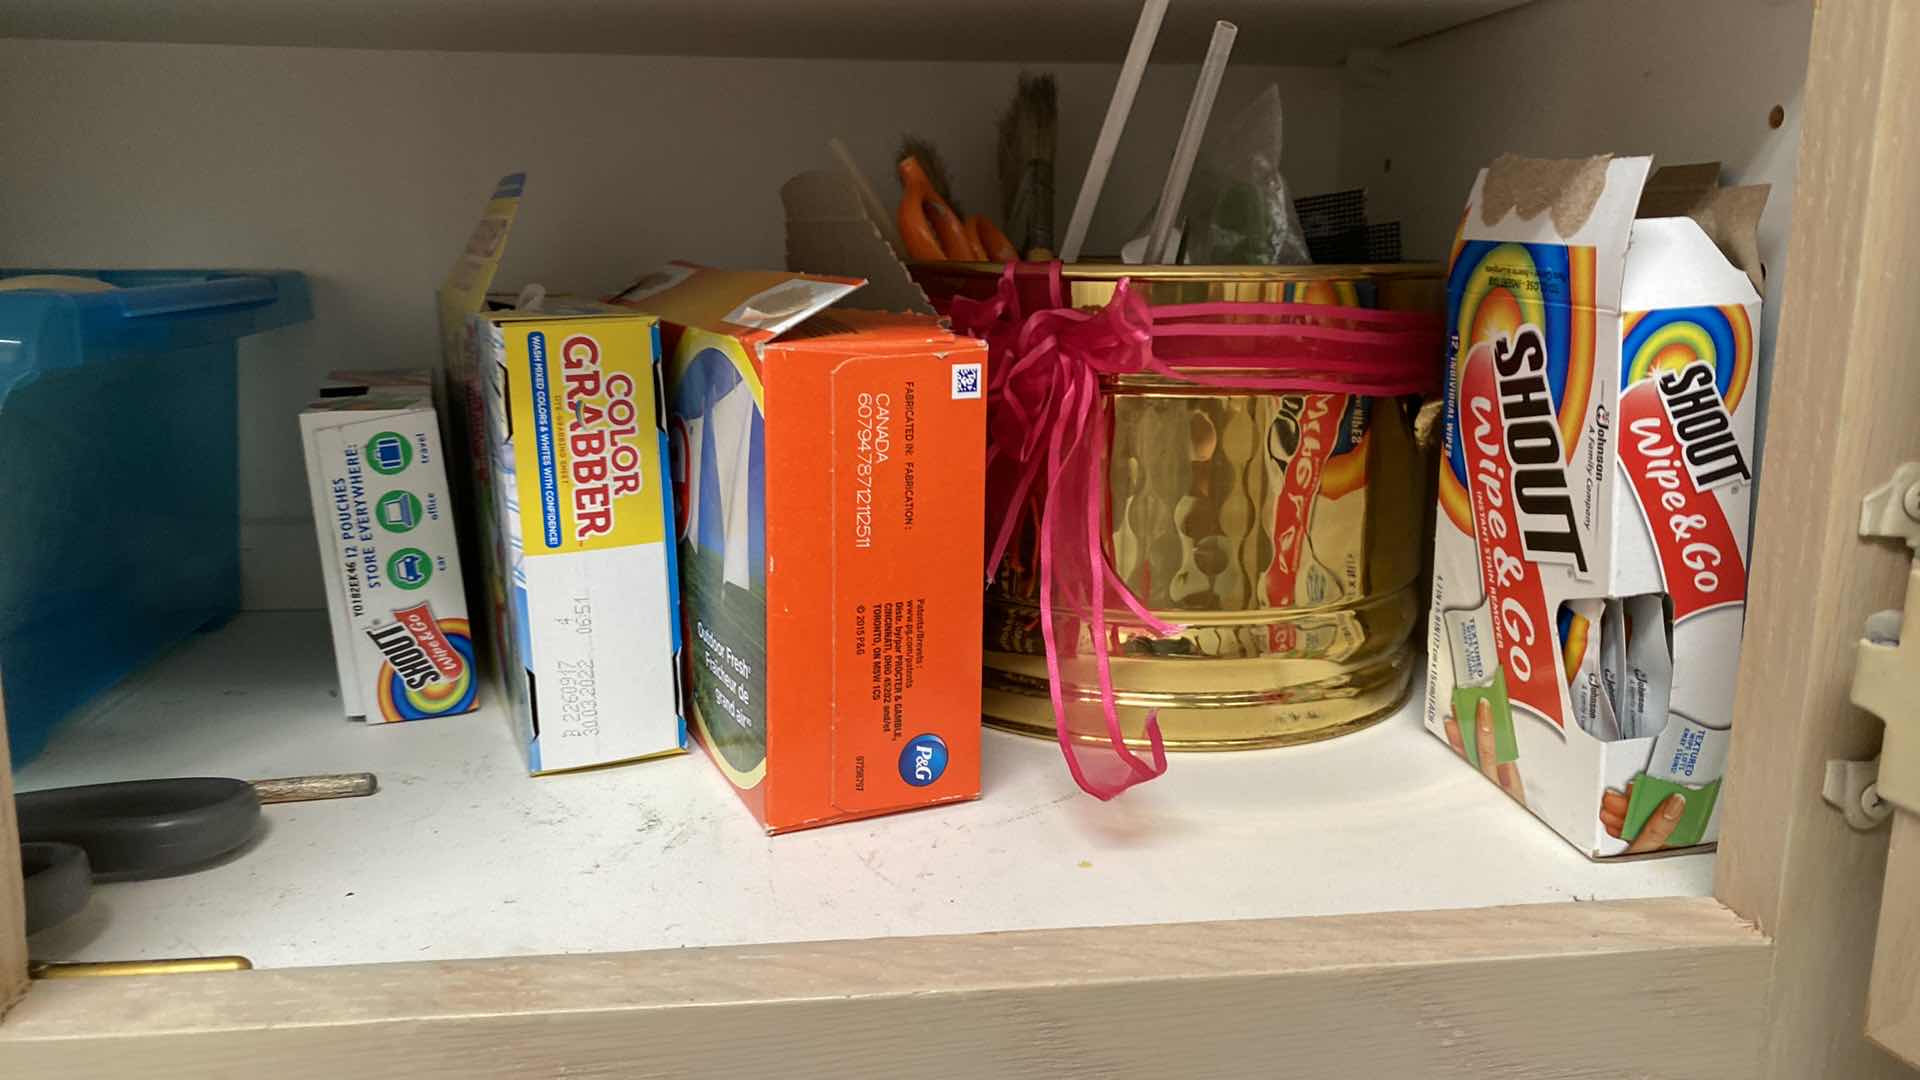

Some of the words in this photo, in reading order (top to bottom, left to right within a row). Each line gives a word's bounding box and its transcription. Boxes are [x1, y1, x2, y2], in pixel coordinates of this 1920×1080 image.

[531, 335, 542, 361] WASH
[535, 362, 545, 390] MIXED
[537, 390, 548, 425] COLORS
[875, 393, 890, 464] CANADA
[905, 381, 914, 442] FABRICATED
[1659, 364, 1751, 487] SHOUT
[416, 433, 429, 464] travel
[541, 433, 551, 465] WHITES
[562, 336, 612, 538] GRABBER
[606, 374, 640, 495] COLOR
[1494, 330, 1588, 573] SHOUT
[1586, 437, 1595, 476] Family
[1596, 404, 1609, 481] Johnson
[544, 466, 553, 489] WITH
[1471, 396, 1507, 539] Wipe
[333, 478, 351, 541] POUCHES
[347, 444, 373, 543] EVERYWHERE:
[427, 492, 439, 521] office
[1477, 491, 1491, 541] INSTANT
[1584, 478, 1593, 530] Company
[545, 490, 559, 545] CONFIDENCE!
[348, 544, 358, 558] 12
[360, 545, 381, 589] STORE
[1485, 544, 1497, 578] STAIN
[1493, 546, 1524, 588] &
[856, 615, 865, 637] 2015
[1489, 580, 1504, 649] REMOVER
[366, 621, 440, 692] SHOUT
[698, 621, 725, 658] Outdoor
[726, 647, 749, 680] Fresh
[856, 636, 865, 656] P&G
[1502, 598, 1536, 683] Go
[884, 654, 892, 676] OHIO
[894, 655, 903, 694] PROCTER
[577, 658, 600, 738] 30.03.2022
[715, 688, 736, 719] grand
[738, 683, 750, 705] de
[915, 745, 933, 781] P&G
[1684, 730, 1706, 777] TEXTURED
